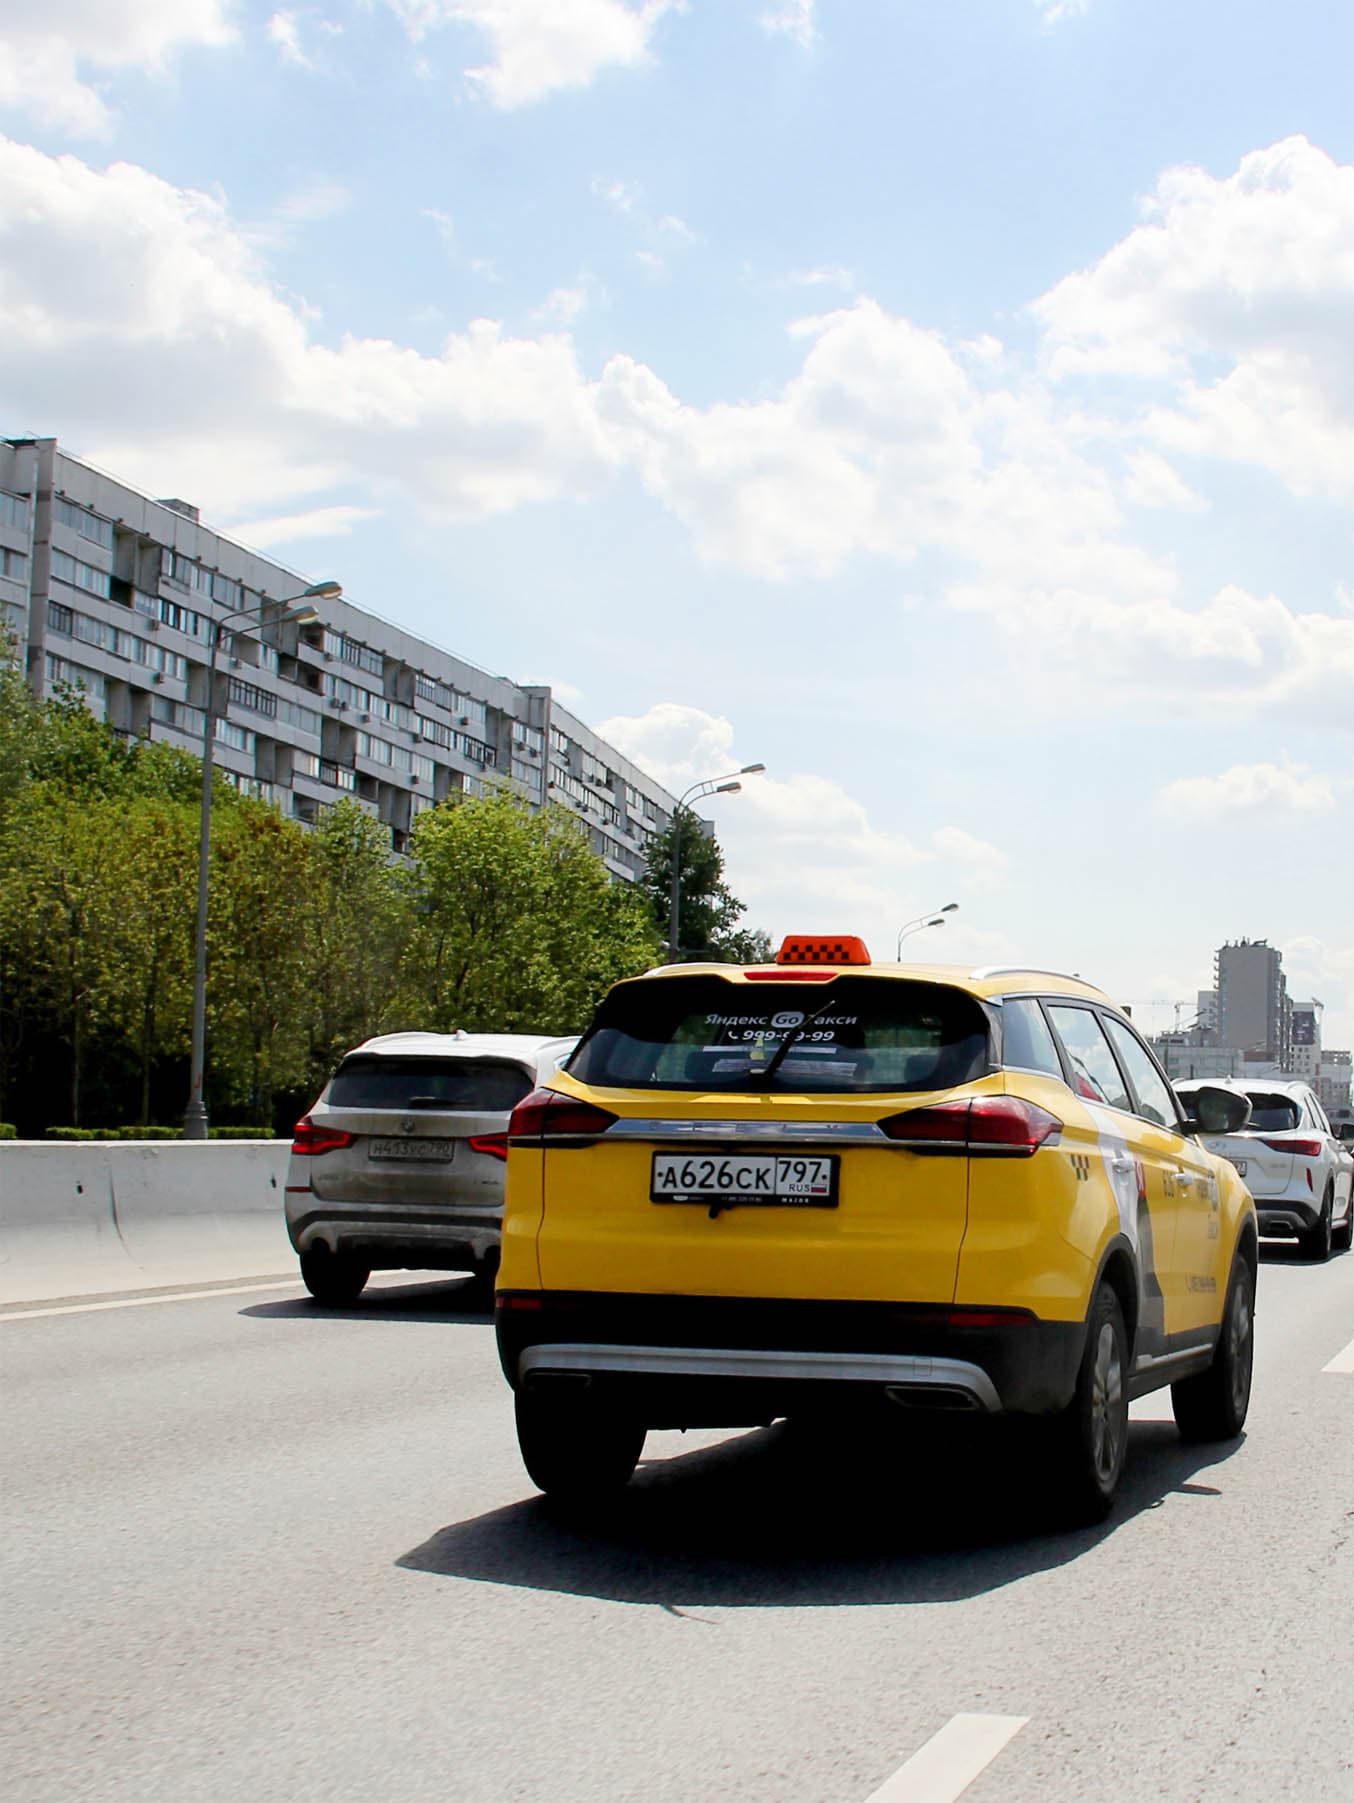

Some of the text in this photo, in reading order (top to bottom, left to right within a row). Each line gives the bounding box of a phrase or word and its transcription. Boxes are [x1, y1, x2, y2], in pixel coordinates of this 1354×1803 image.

[704, 1013, 769, 1026] Яндекс
[774, 1013, 801, 1026] Go
[661, 1159, 823, 1190] А626СК 797
[788, 1184, 810, 1193] RUS
